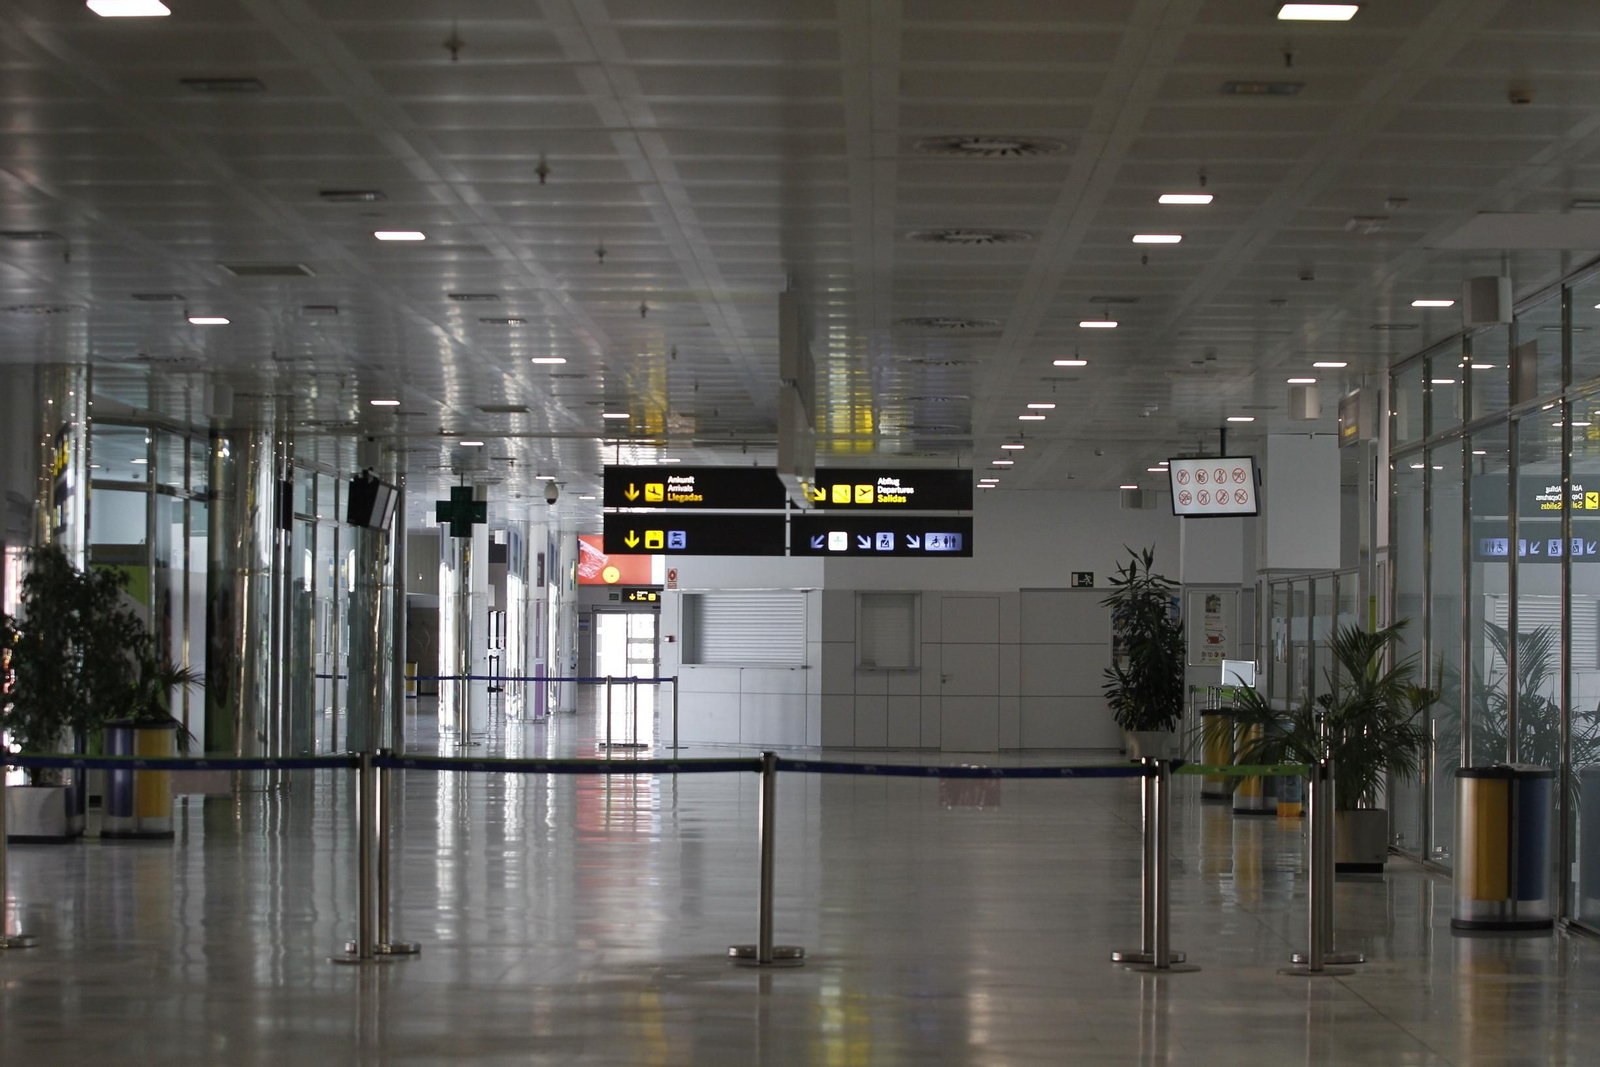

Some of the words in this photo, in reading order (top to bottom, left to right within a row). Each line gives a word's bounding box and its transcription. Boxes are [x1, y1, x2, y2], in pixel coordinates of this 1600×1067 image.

[877, 477, 900, 487] Abflug
[667, 484, 693, 492] Arrivals
[877, 485, 914, 494] Departures
[667, 492, 703, 503] Llegadas
[877, 494, 907, 503] Salidas
